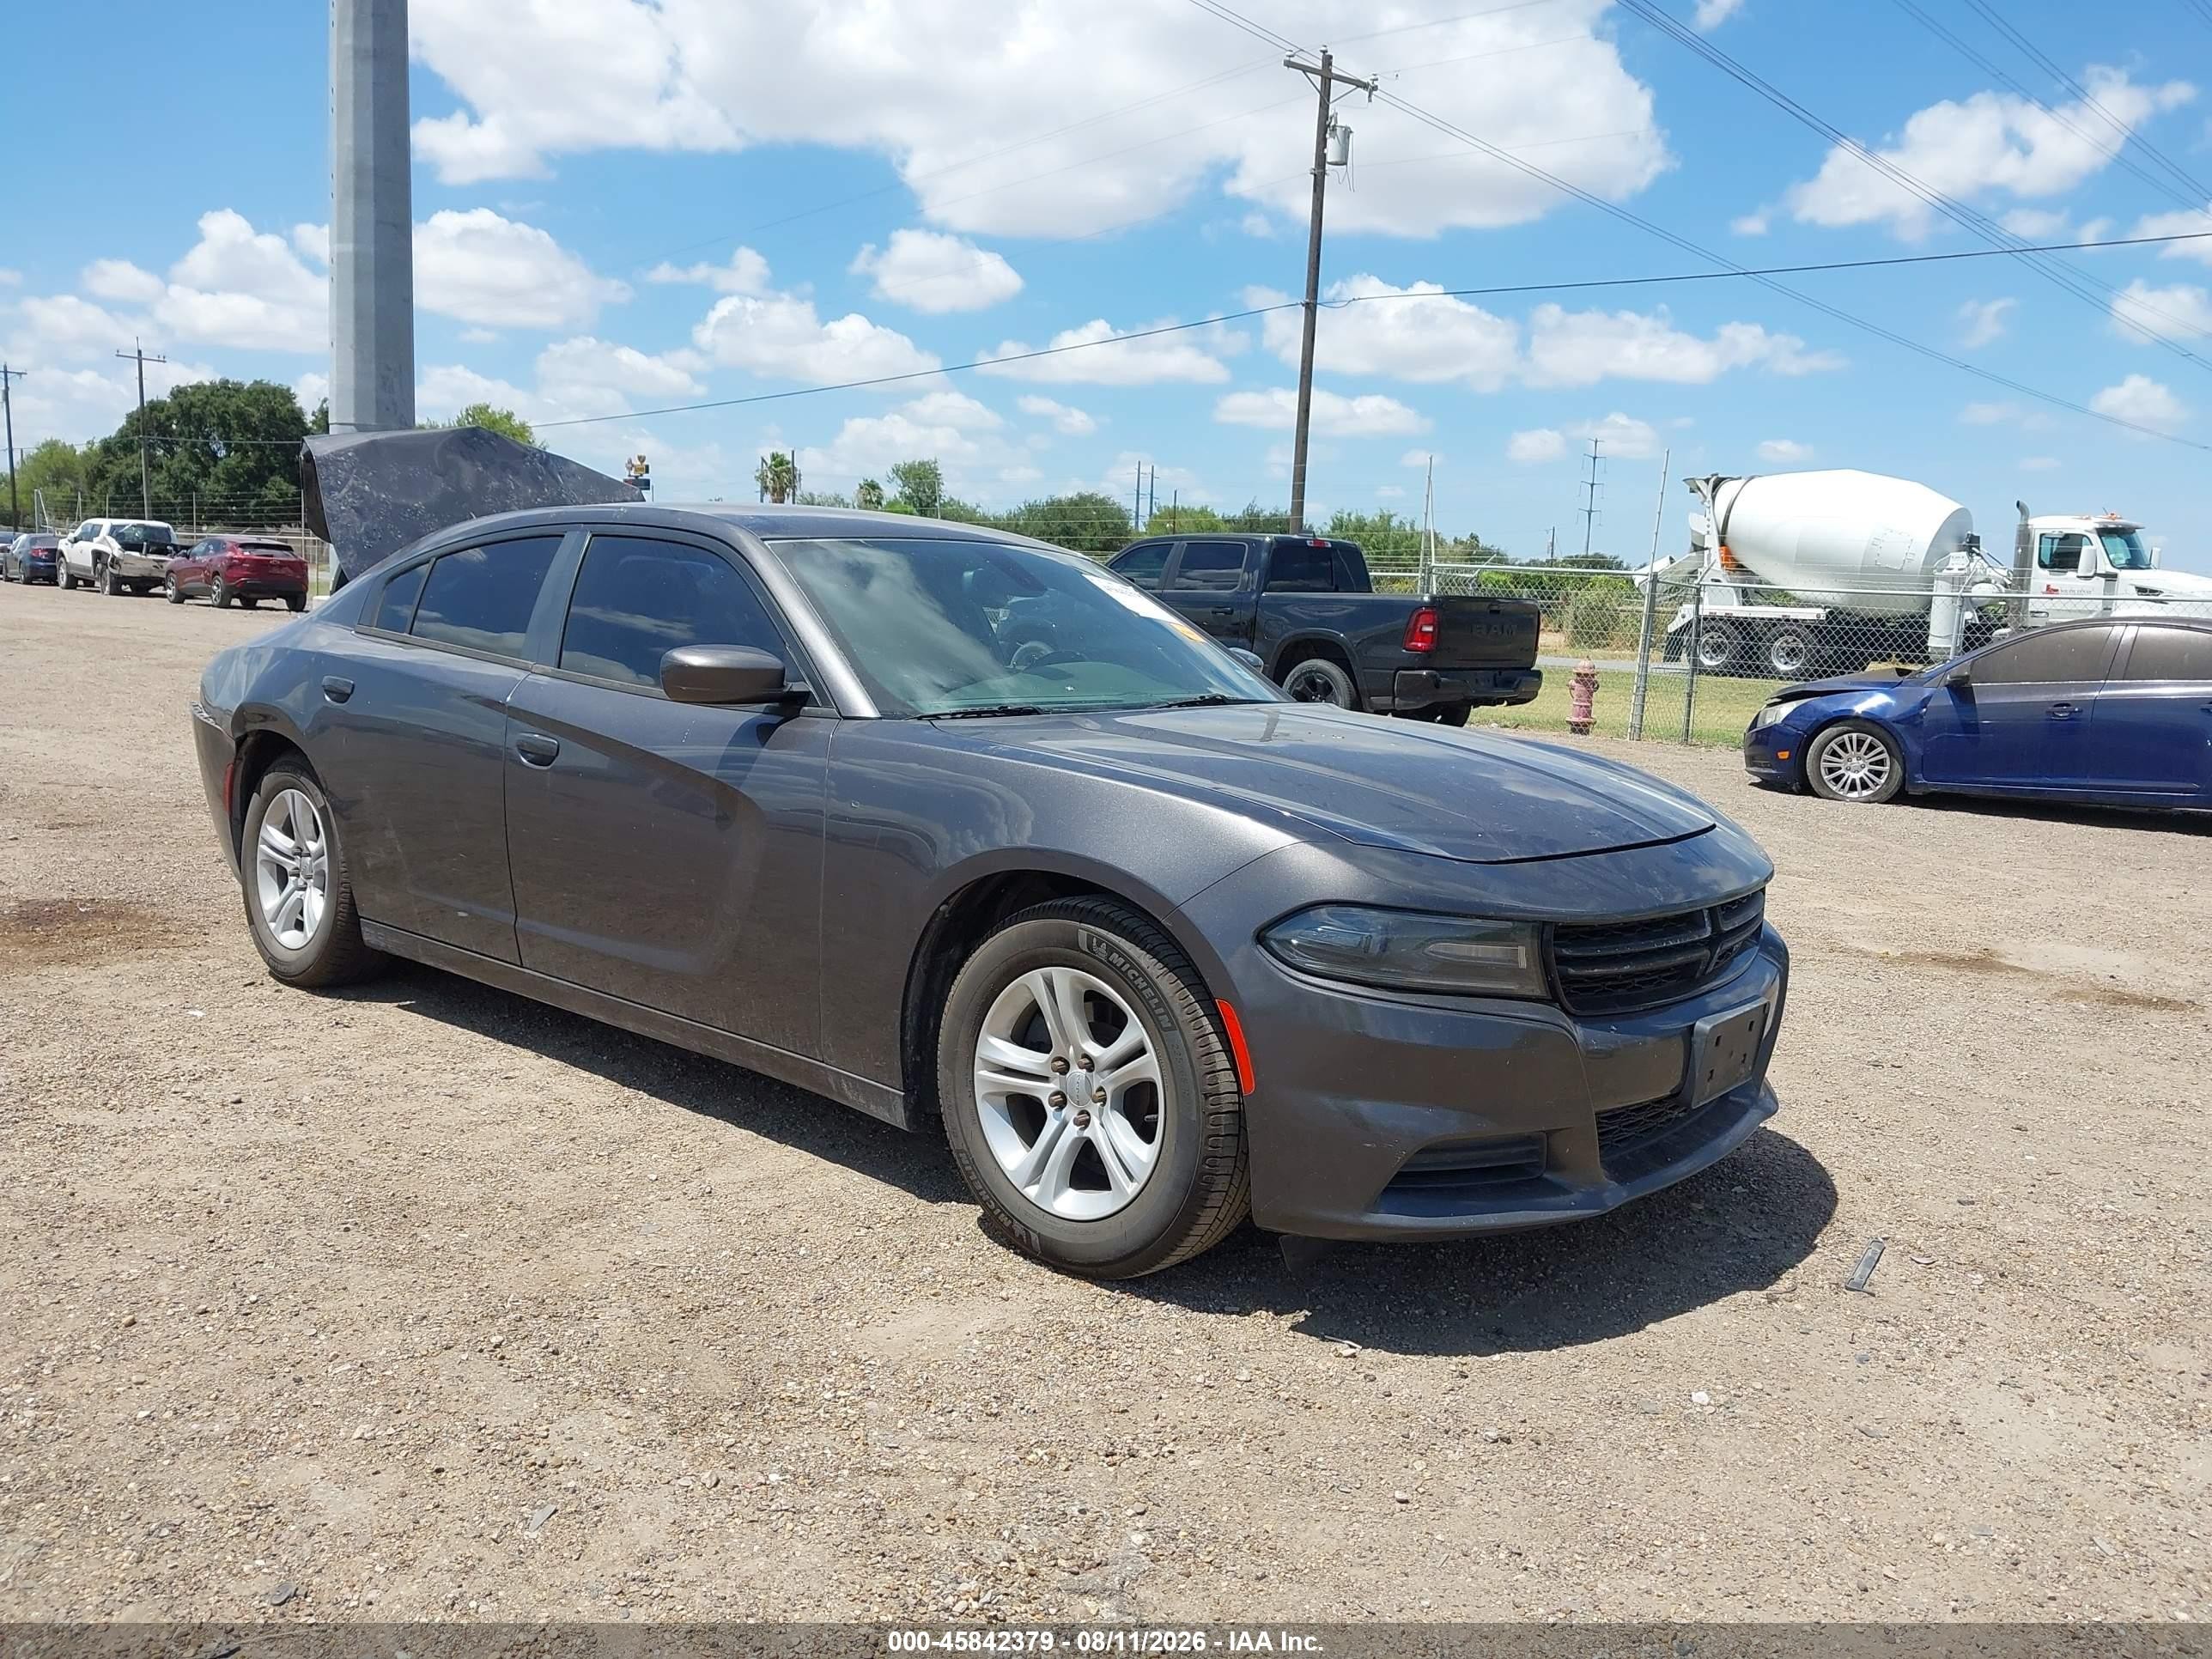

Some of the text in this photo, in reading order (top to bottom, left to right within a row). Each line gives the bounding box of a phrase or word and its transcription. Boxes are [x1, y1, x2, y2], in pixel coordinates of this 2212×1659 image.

[1469, 624, 1519, 638] RAM
[1109, 952, 1171, 1030] MICHELIN
[959, 1152, 1012, 1227] MICHELIN
